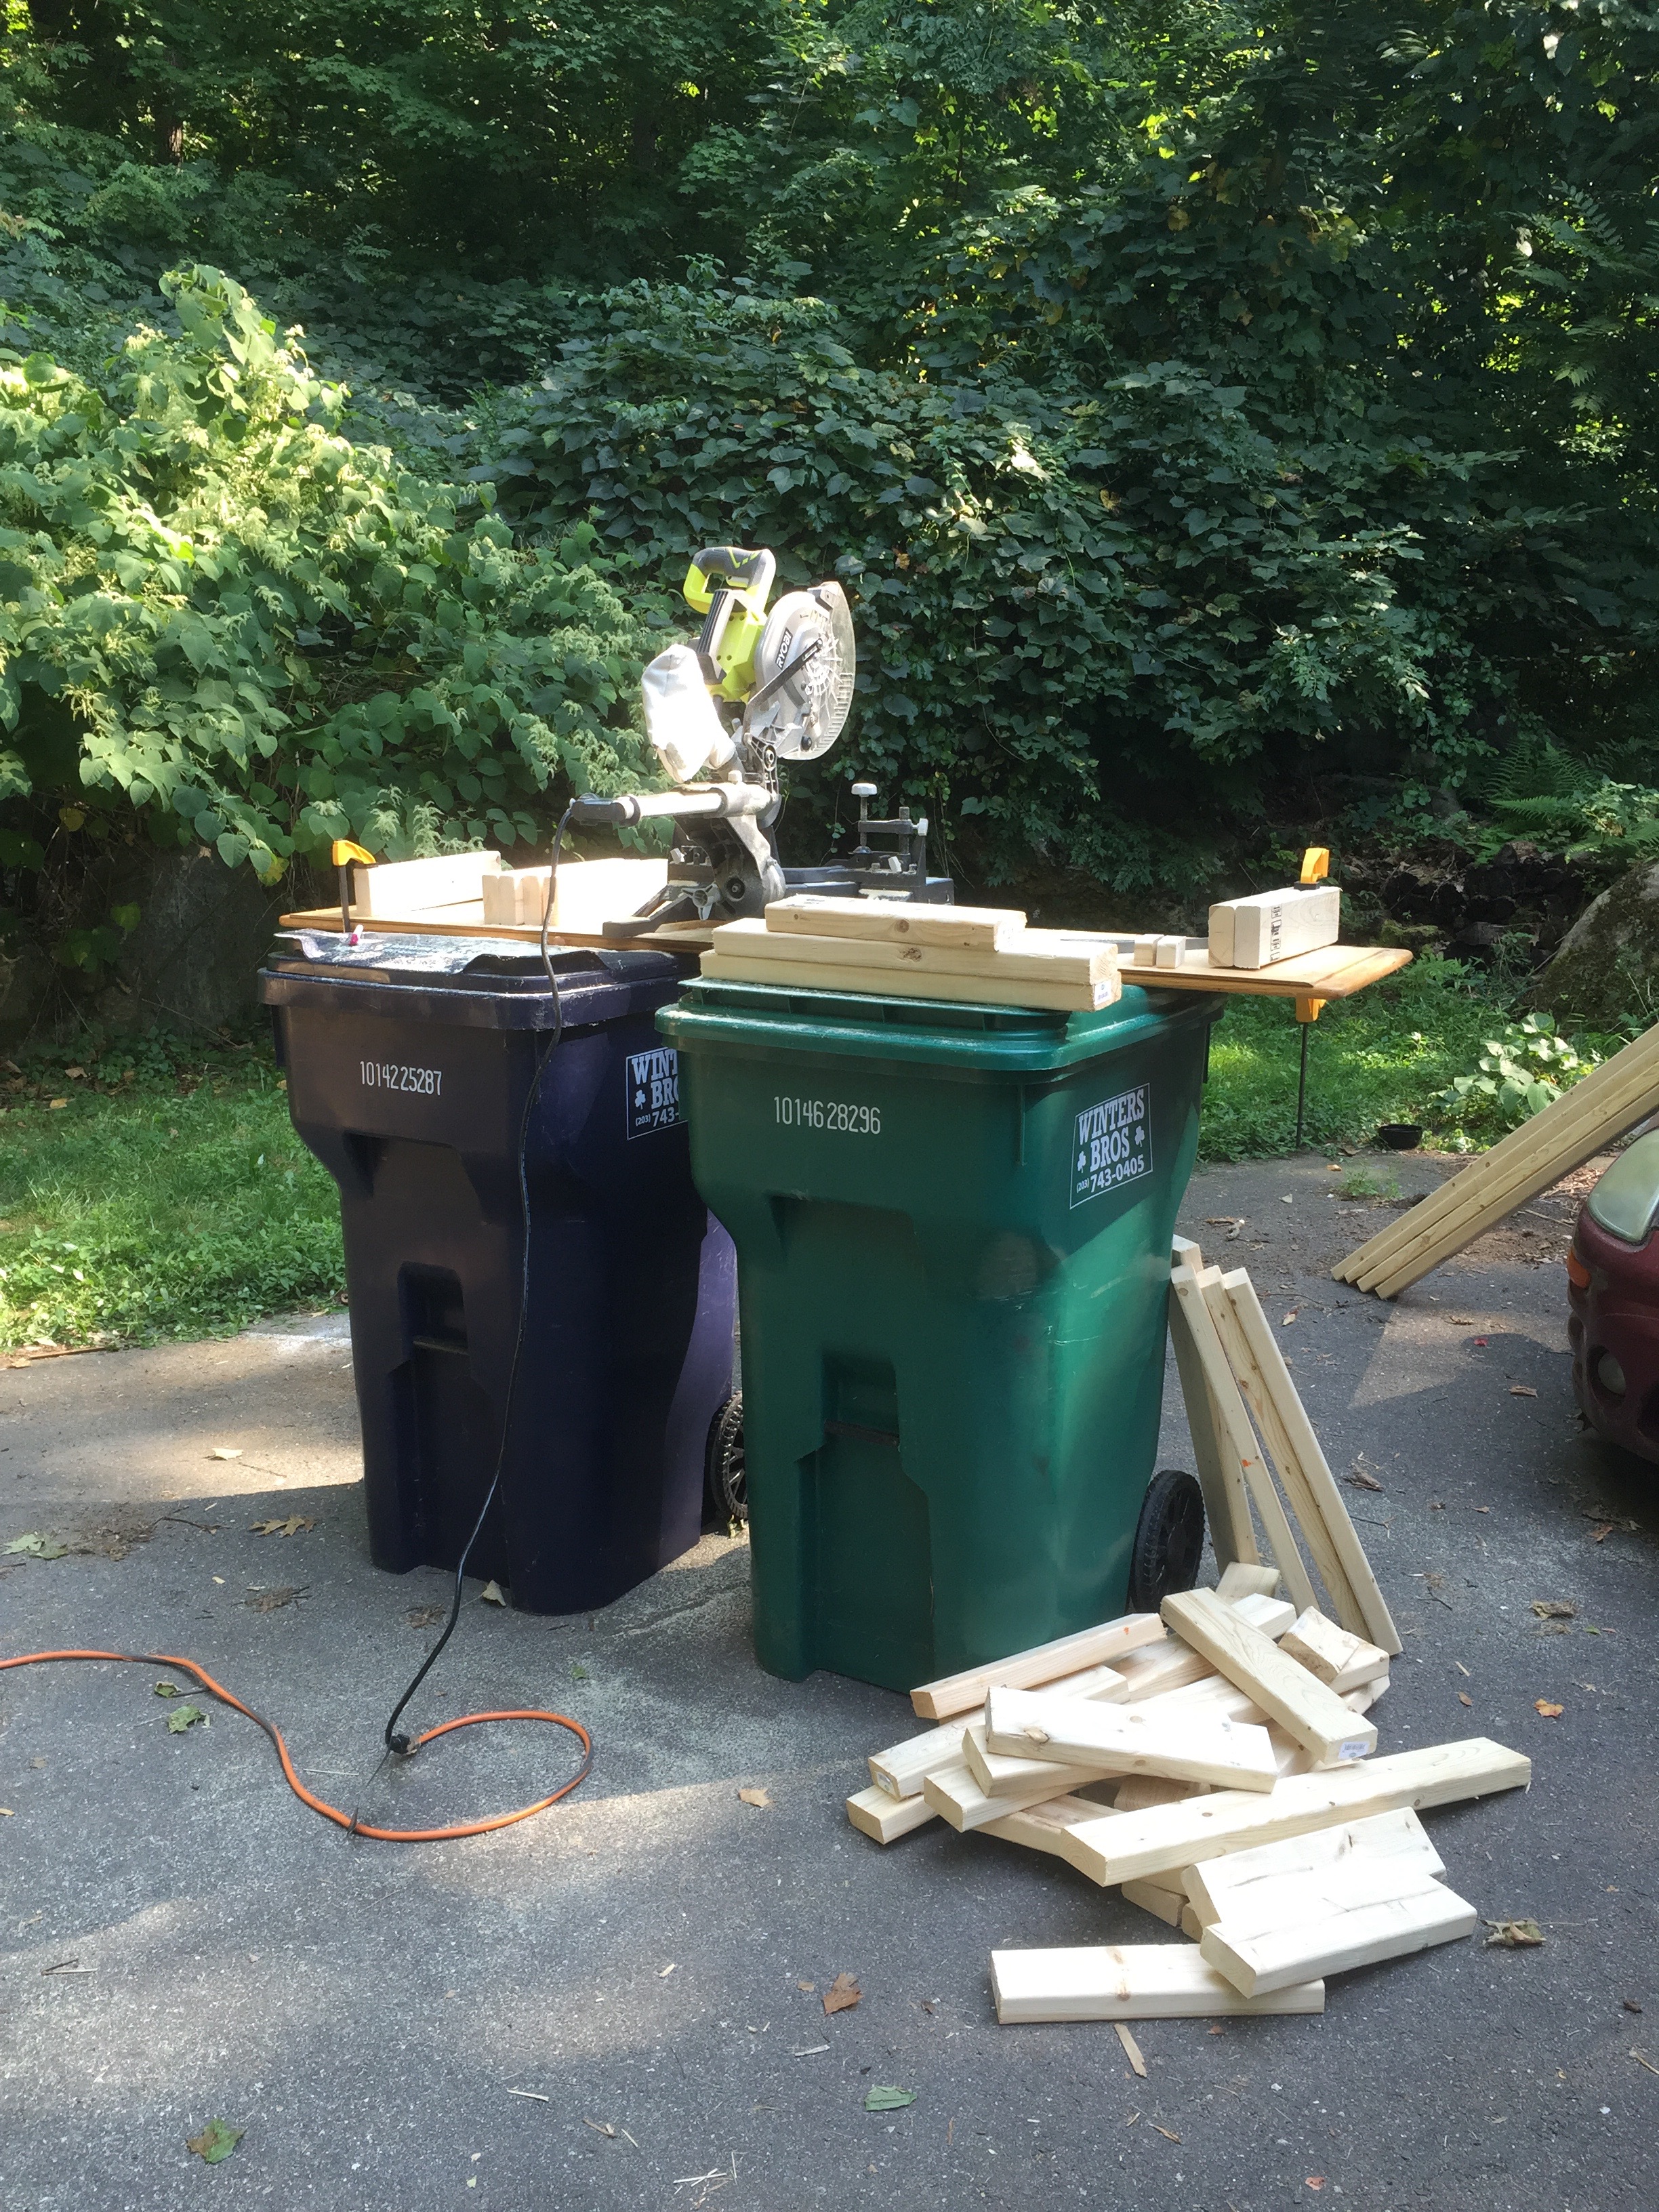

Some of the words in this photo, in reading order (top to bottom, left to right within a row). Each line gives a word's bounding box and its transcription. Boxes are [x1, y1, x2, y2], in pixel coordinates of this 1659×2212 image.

[776, 631, 792, 668] RYOBI
[360, 1061, 442, 1096] 1014225287
[635, 1113, 651, 1127] (203)
[774, 1097, 880, 1134] 1014628296
[1078, 1088, 1145, 1145] WINTERS
[1090, 1126, 1130, 1172] BROS
[1076, 1178, 1090, 1193] (203)
[1090, 1154, 1144, 1193] 743-0405
